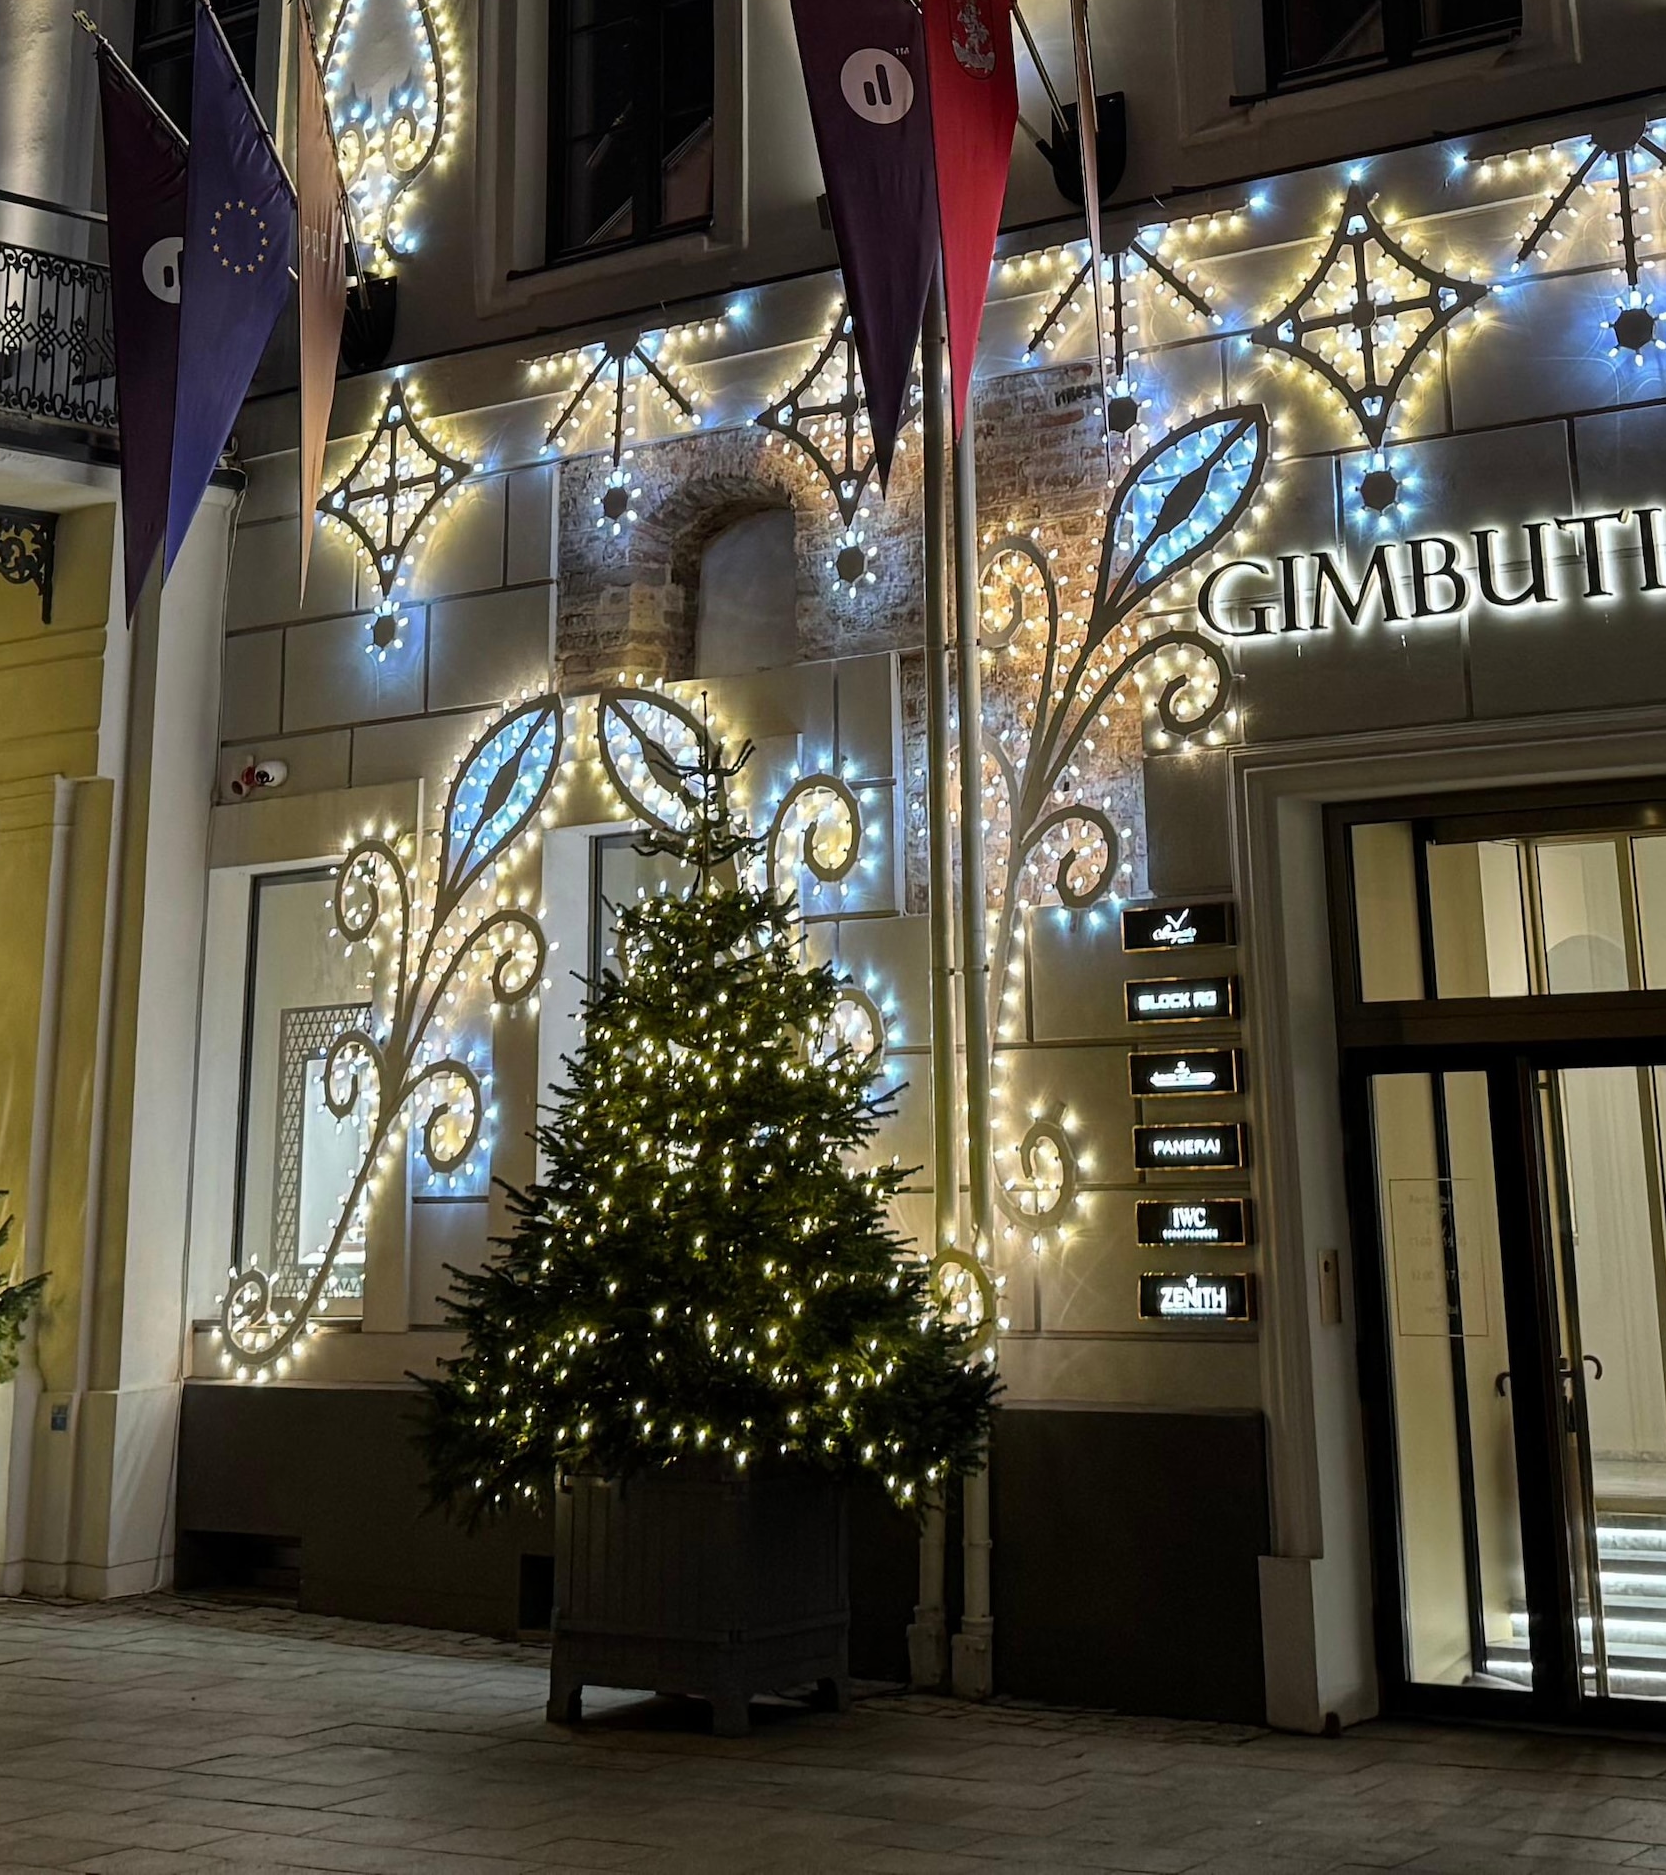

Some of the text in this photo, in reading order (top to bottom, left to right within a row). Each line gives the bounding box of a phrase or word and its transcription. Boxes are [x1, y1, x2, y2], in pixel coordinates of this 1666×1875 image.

[1153, 1138, 1221, 1156] PANERAI
[1172, 1207, 1207, 1229] IWC
[1160, 1286, 1227, 1309] ZENITH
